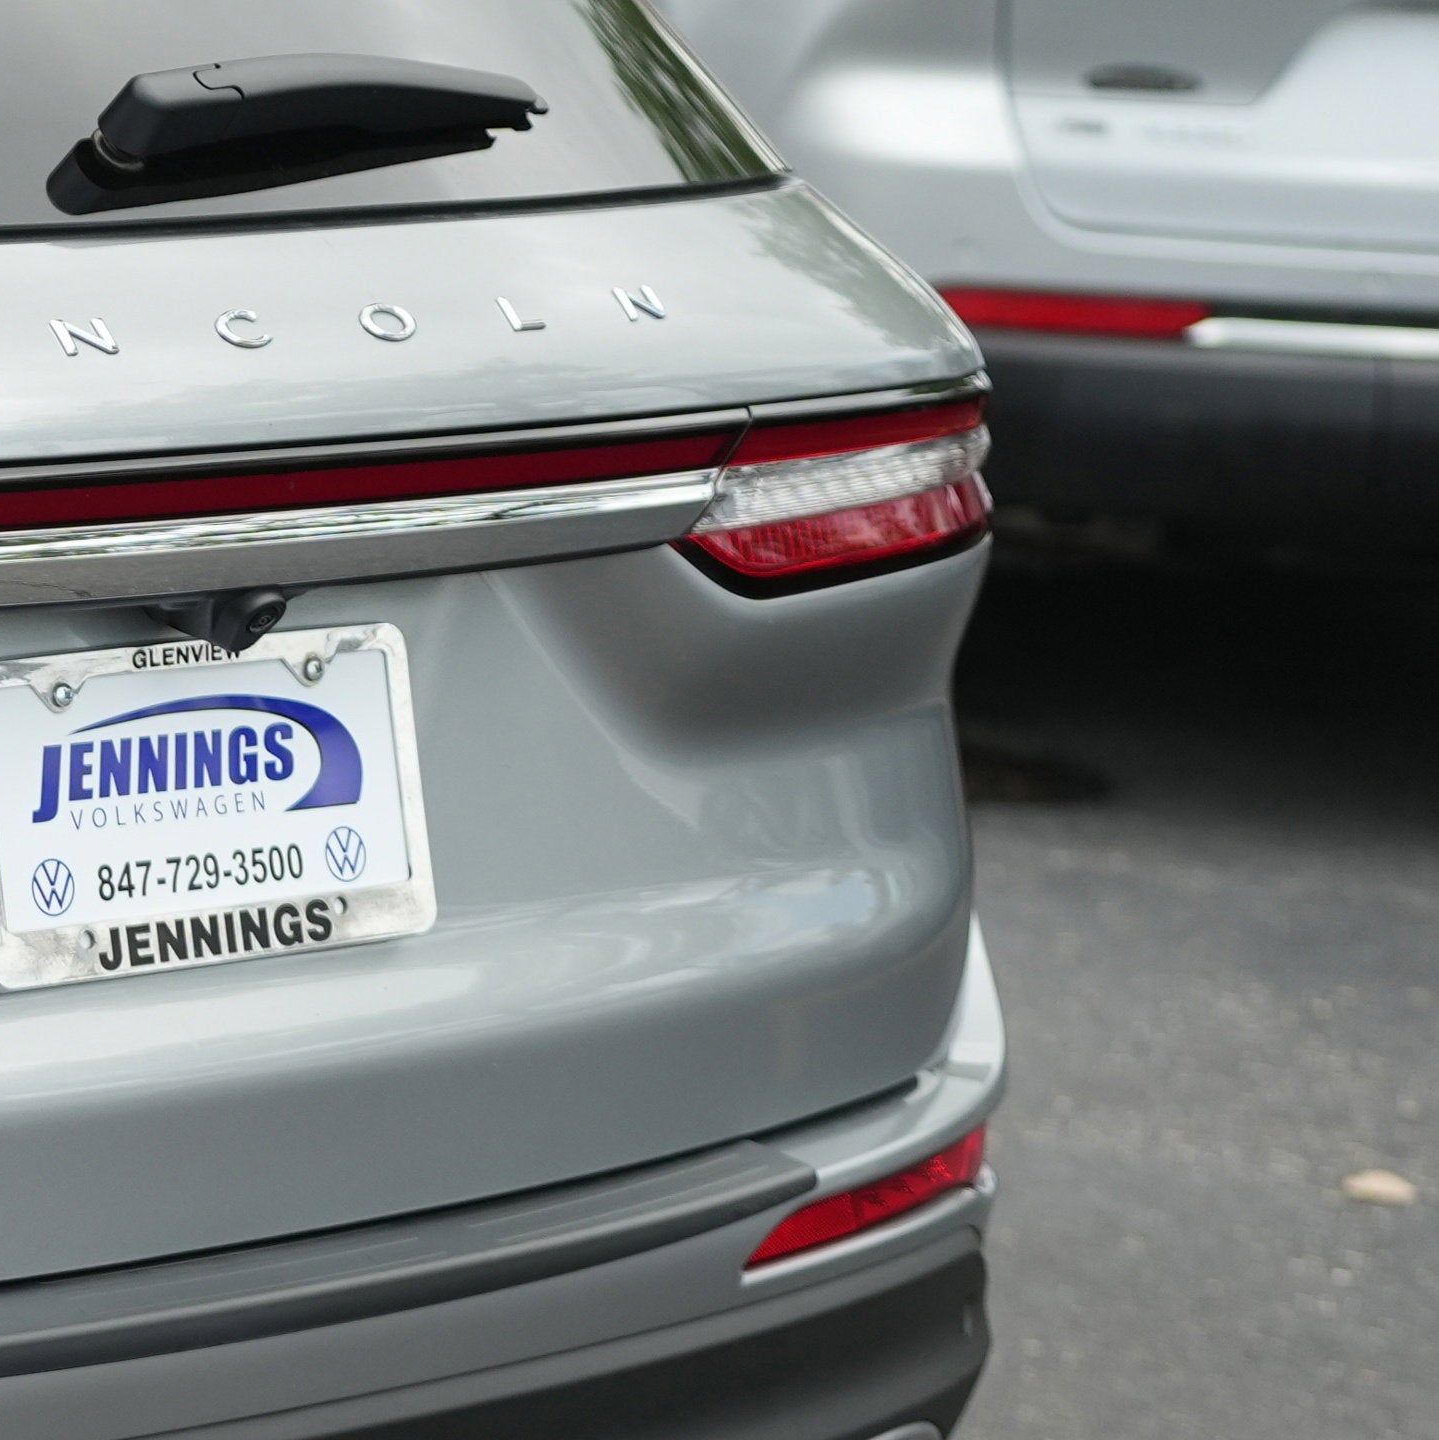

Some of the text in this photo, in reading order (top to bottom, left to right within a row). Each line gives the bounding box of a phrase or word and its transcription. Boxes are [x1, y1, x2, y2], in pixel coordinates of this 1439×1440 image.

[31, 722, 295, 824] JENNINGS
[70, 792, 266, 830] VOLKSWAGEN
[97, 843, 304, 901] 847-729-3500
[98, 897, 334, 972] JENNINGS
